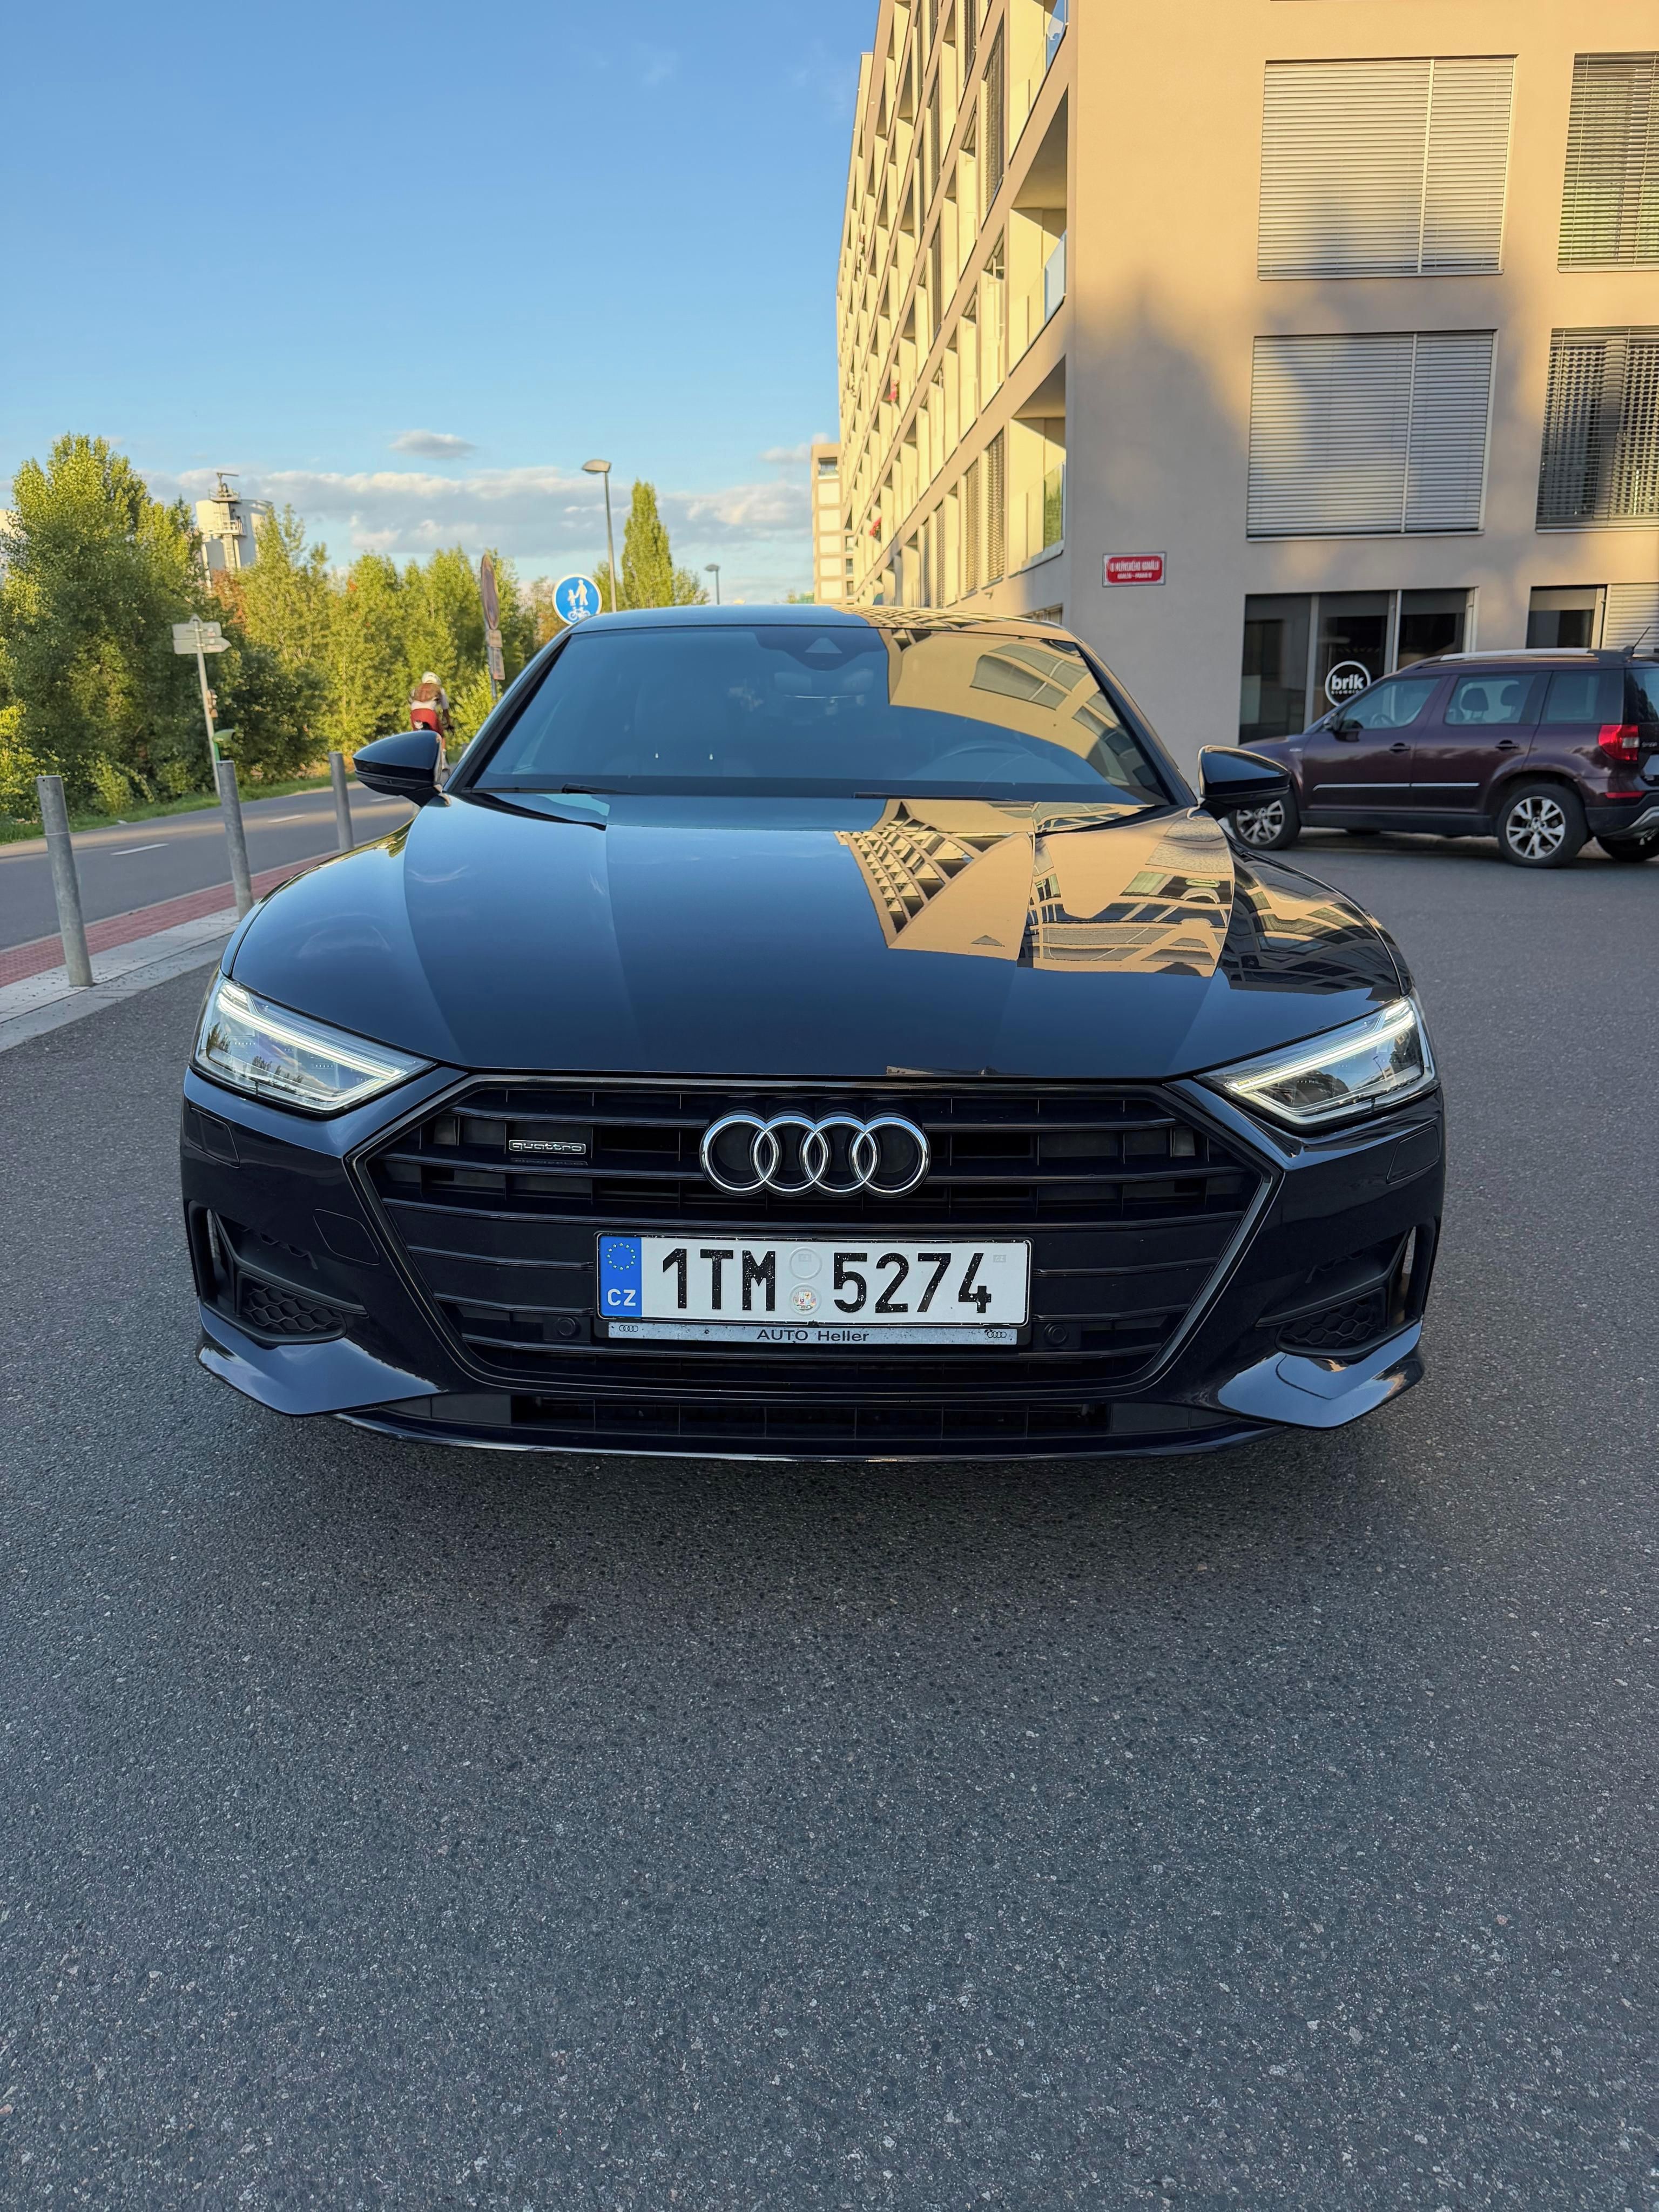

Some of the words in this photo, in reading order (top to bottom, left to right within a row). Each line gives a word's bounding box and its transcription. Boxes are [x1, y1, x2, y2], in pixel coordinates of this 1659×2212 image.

[1331, 674, 1364, 690] brik
[512, 1143, 582, 1151] quattro
[663, 1248, 775, 1311] 1TM
[833, 1252, 992, 1313] 5274
[607, 1289, 636, 1306] CZ
[757, 1329, 808, 1340] AUTO
[818, 1330, 869, 1341] Heller
